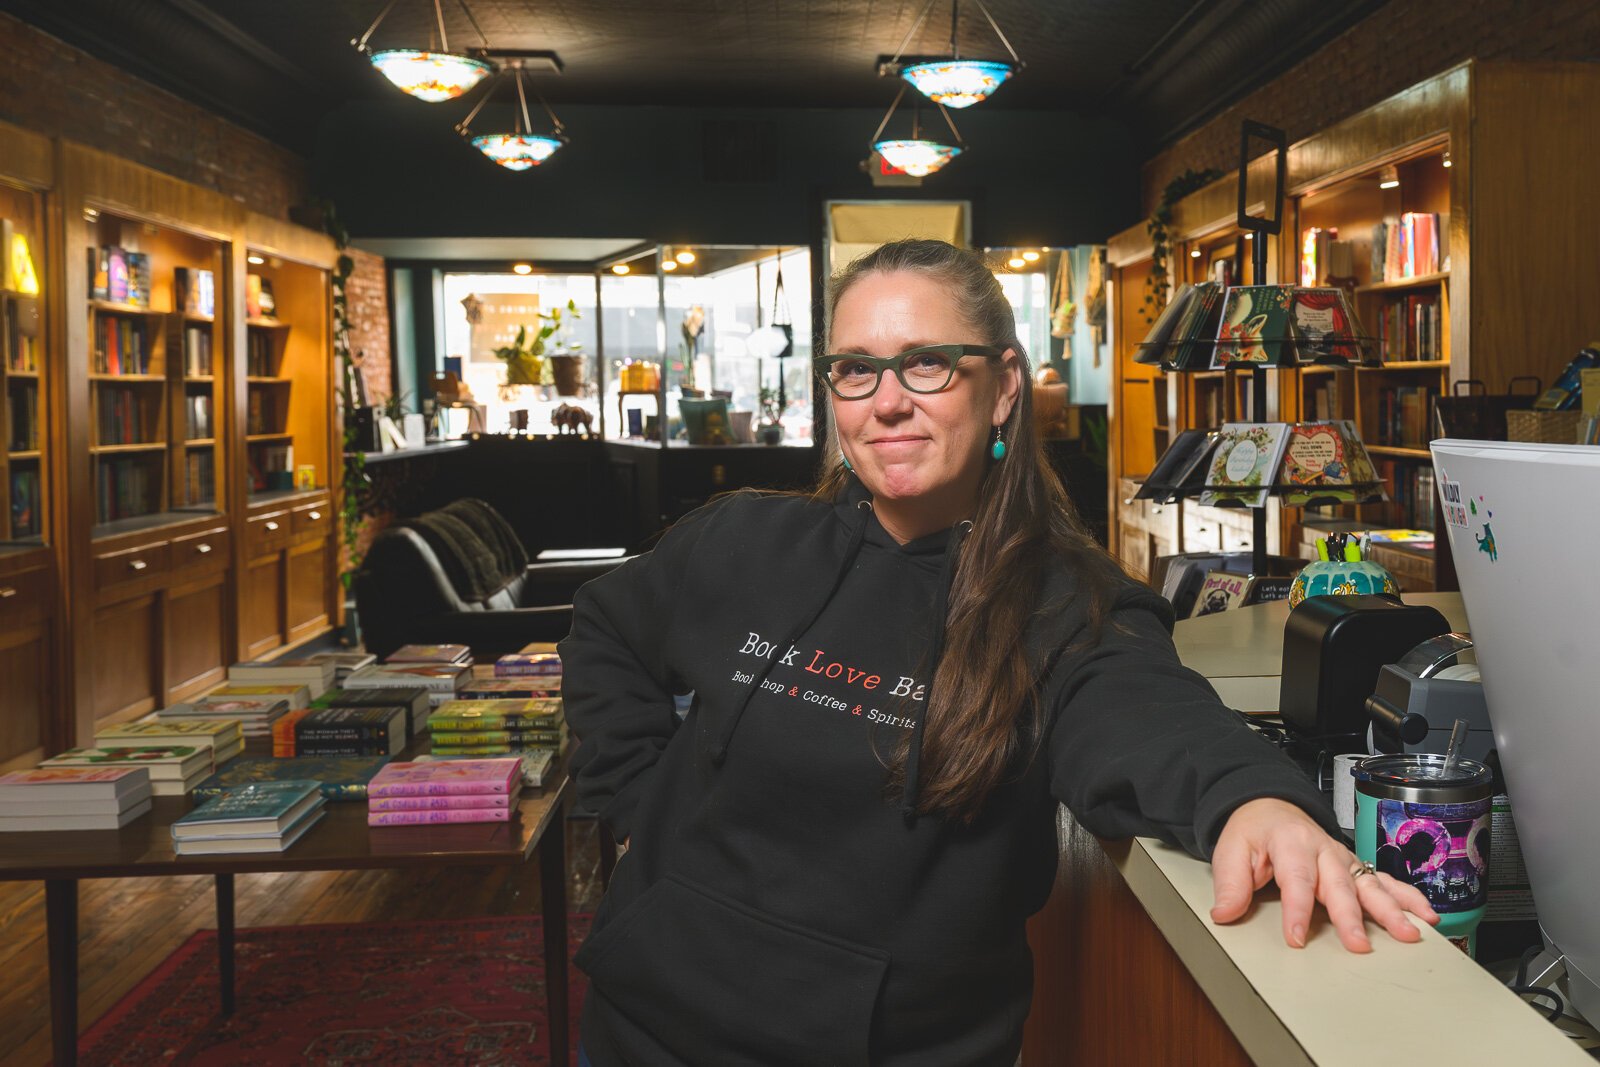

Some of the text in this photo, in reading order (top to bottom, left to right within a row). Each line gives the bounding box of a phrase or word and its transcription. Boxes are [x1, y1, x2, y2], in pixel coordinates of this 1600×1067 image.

[804, 649, 881, 690] Love
[788, 686, 799, 697] &
[802, 690, 848, 712] Coffee
[851, 704, 863, 716] &
[867, 708, 916, 729] Spirits
